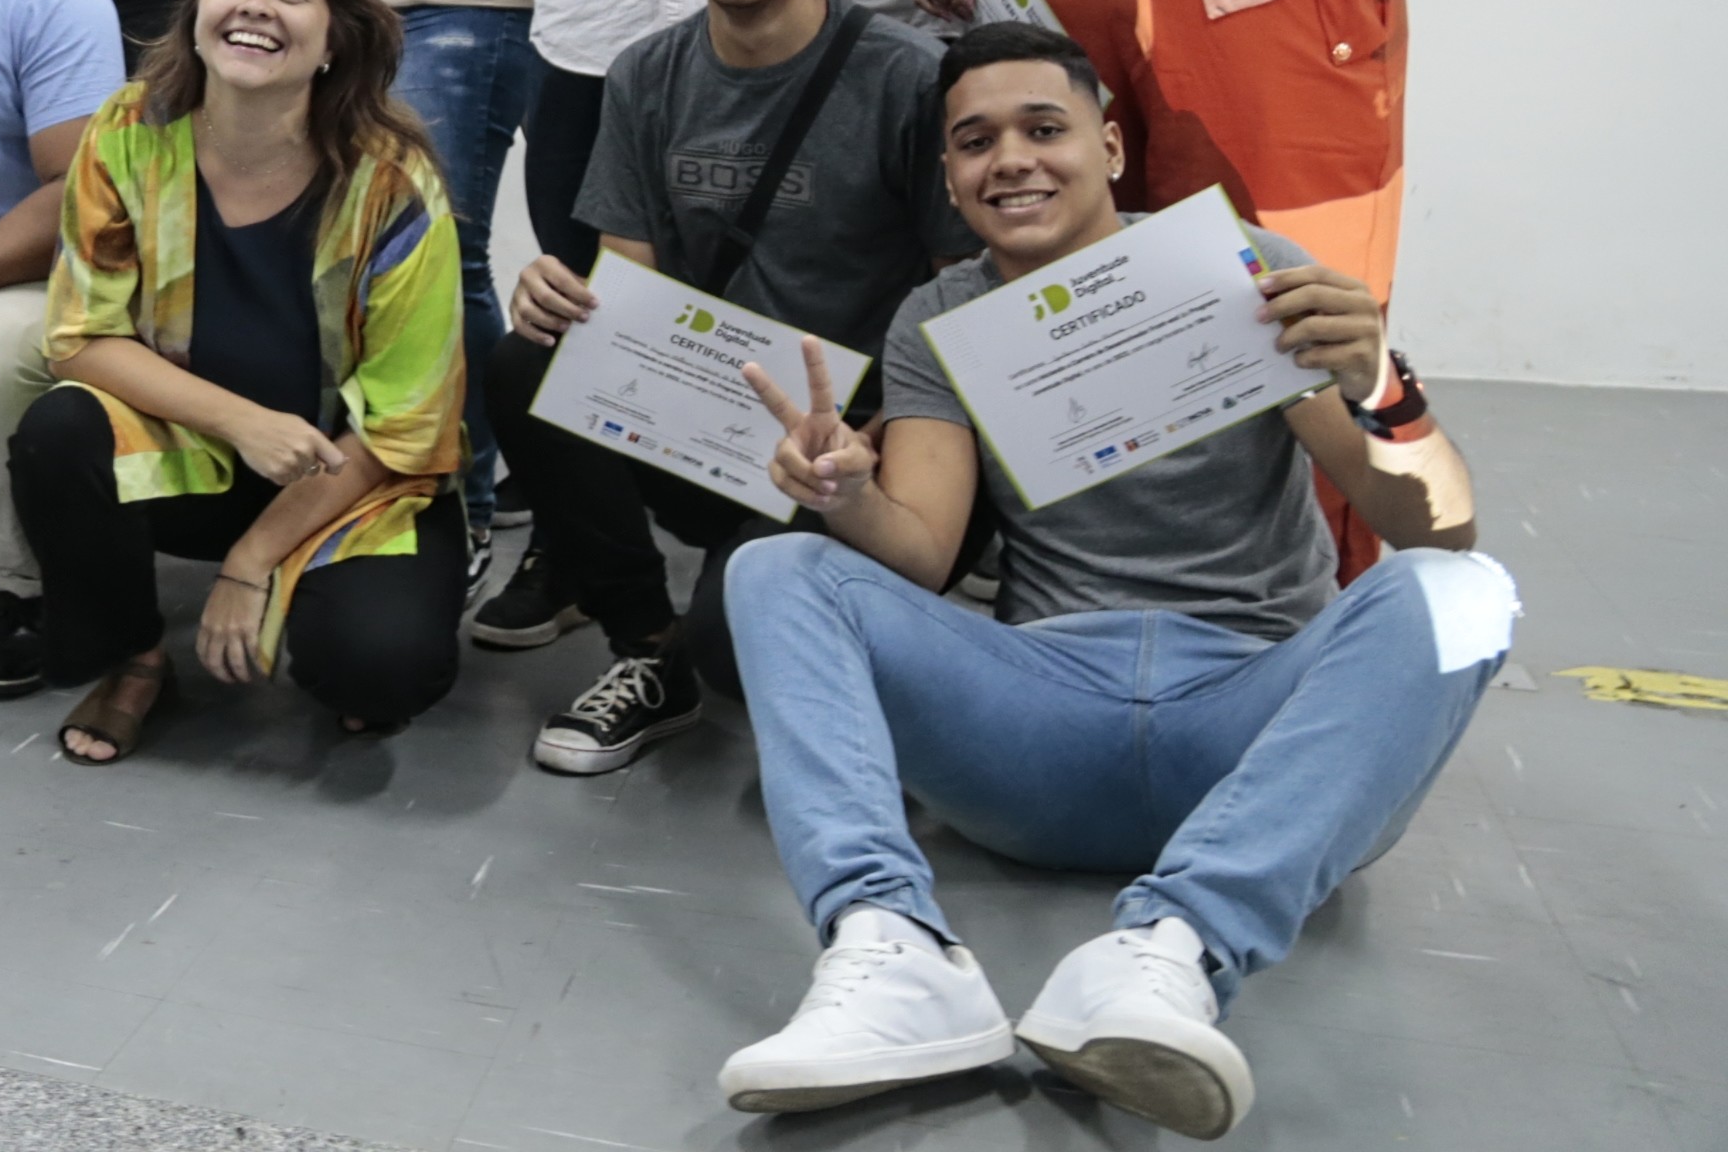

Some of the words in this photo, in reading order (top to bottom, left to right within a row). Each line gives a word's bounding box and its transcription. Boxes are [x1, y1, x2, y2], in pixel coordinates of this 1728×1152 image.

[1070, 255, 1129, 286] Juventude
[1049, 290, 1147, 341] CERTIFICADO
[718, 320, 772, 346] Juventude
[670, 334, 746, 370] CERTIFICAD
